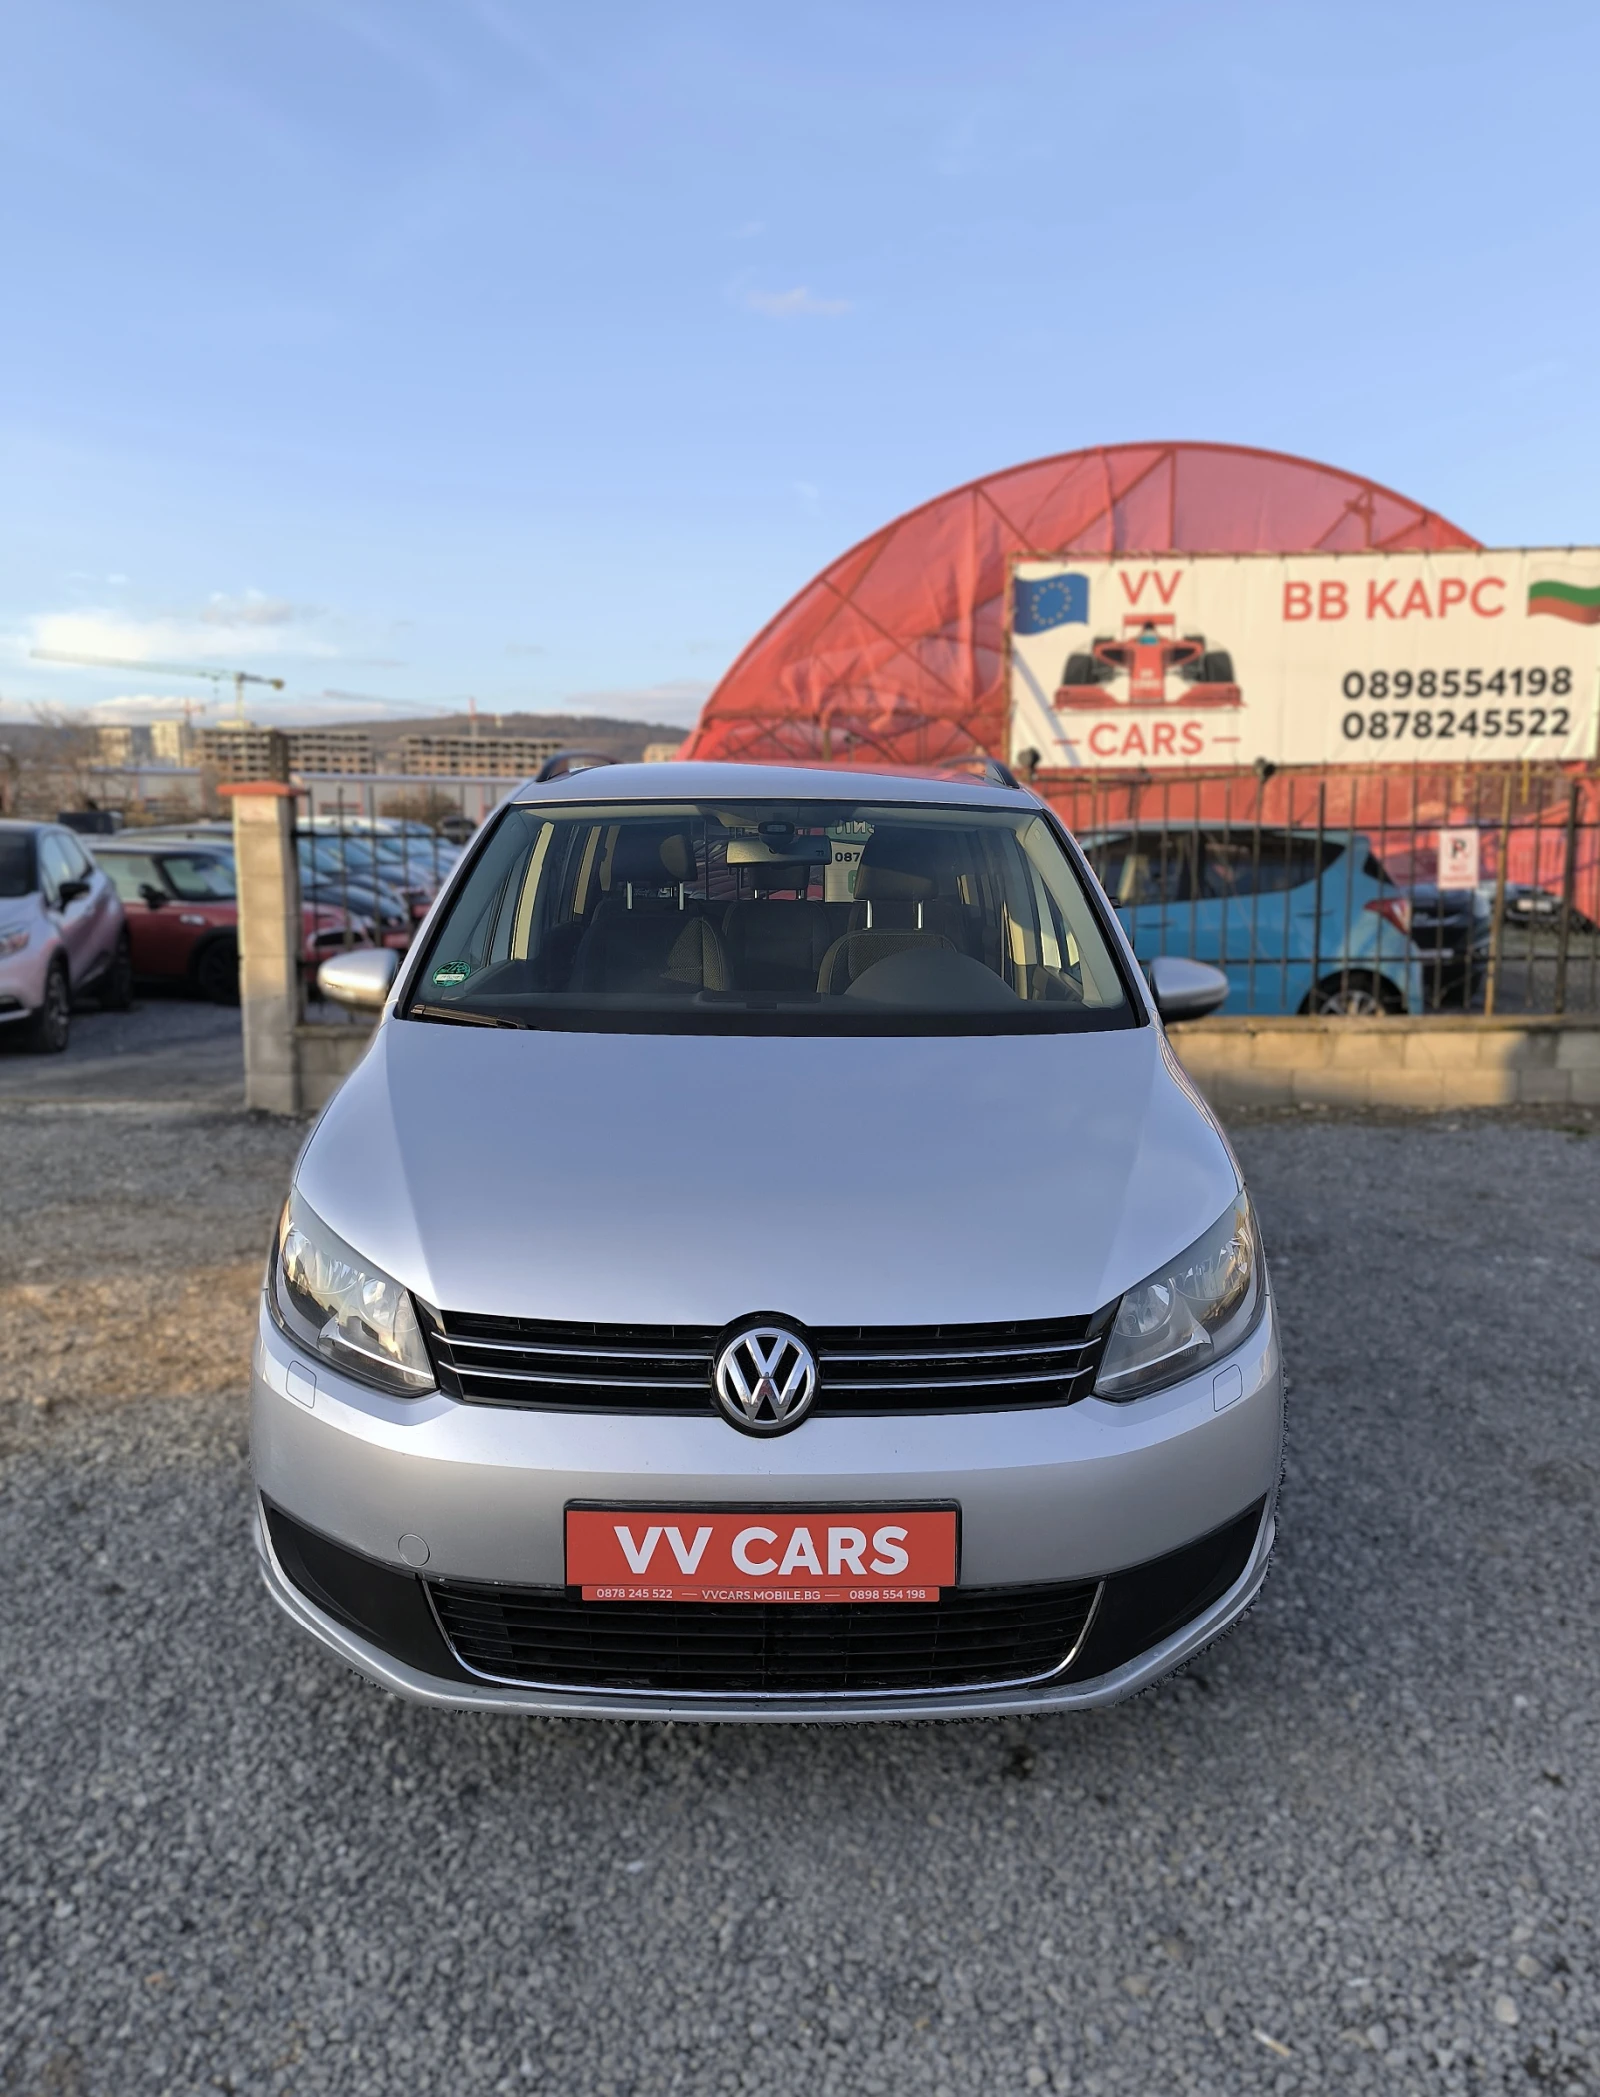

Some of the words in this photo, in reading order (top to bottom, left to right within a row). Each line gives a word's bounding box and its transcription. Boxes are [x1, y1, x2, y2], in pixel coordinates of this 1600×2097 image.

[1119, 570, 1182, 606] VV
[1341, 666, 1573, 700] 0898554198
[1088, 721, 1204, 757] CARS
[1341, 708, 1570, 740] 0878245522
[613, 1525, 714, 1575] VV
[730, 1526, 910, 1576] CARS
[596, 1588, 626, 1598] 0878
[628, 1589, 649, 1598] 245
[652, 1589, 673, 1599] 522
[701, 1590, 821, 1600] VVCARS.MOBILE.BG
[849, 1590, 880, 1600] 0898
[882, 1590, 903, 1600] 554
[906, 1589, 926, 1599] 198
